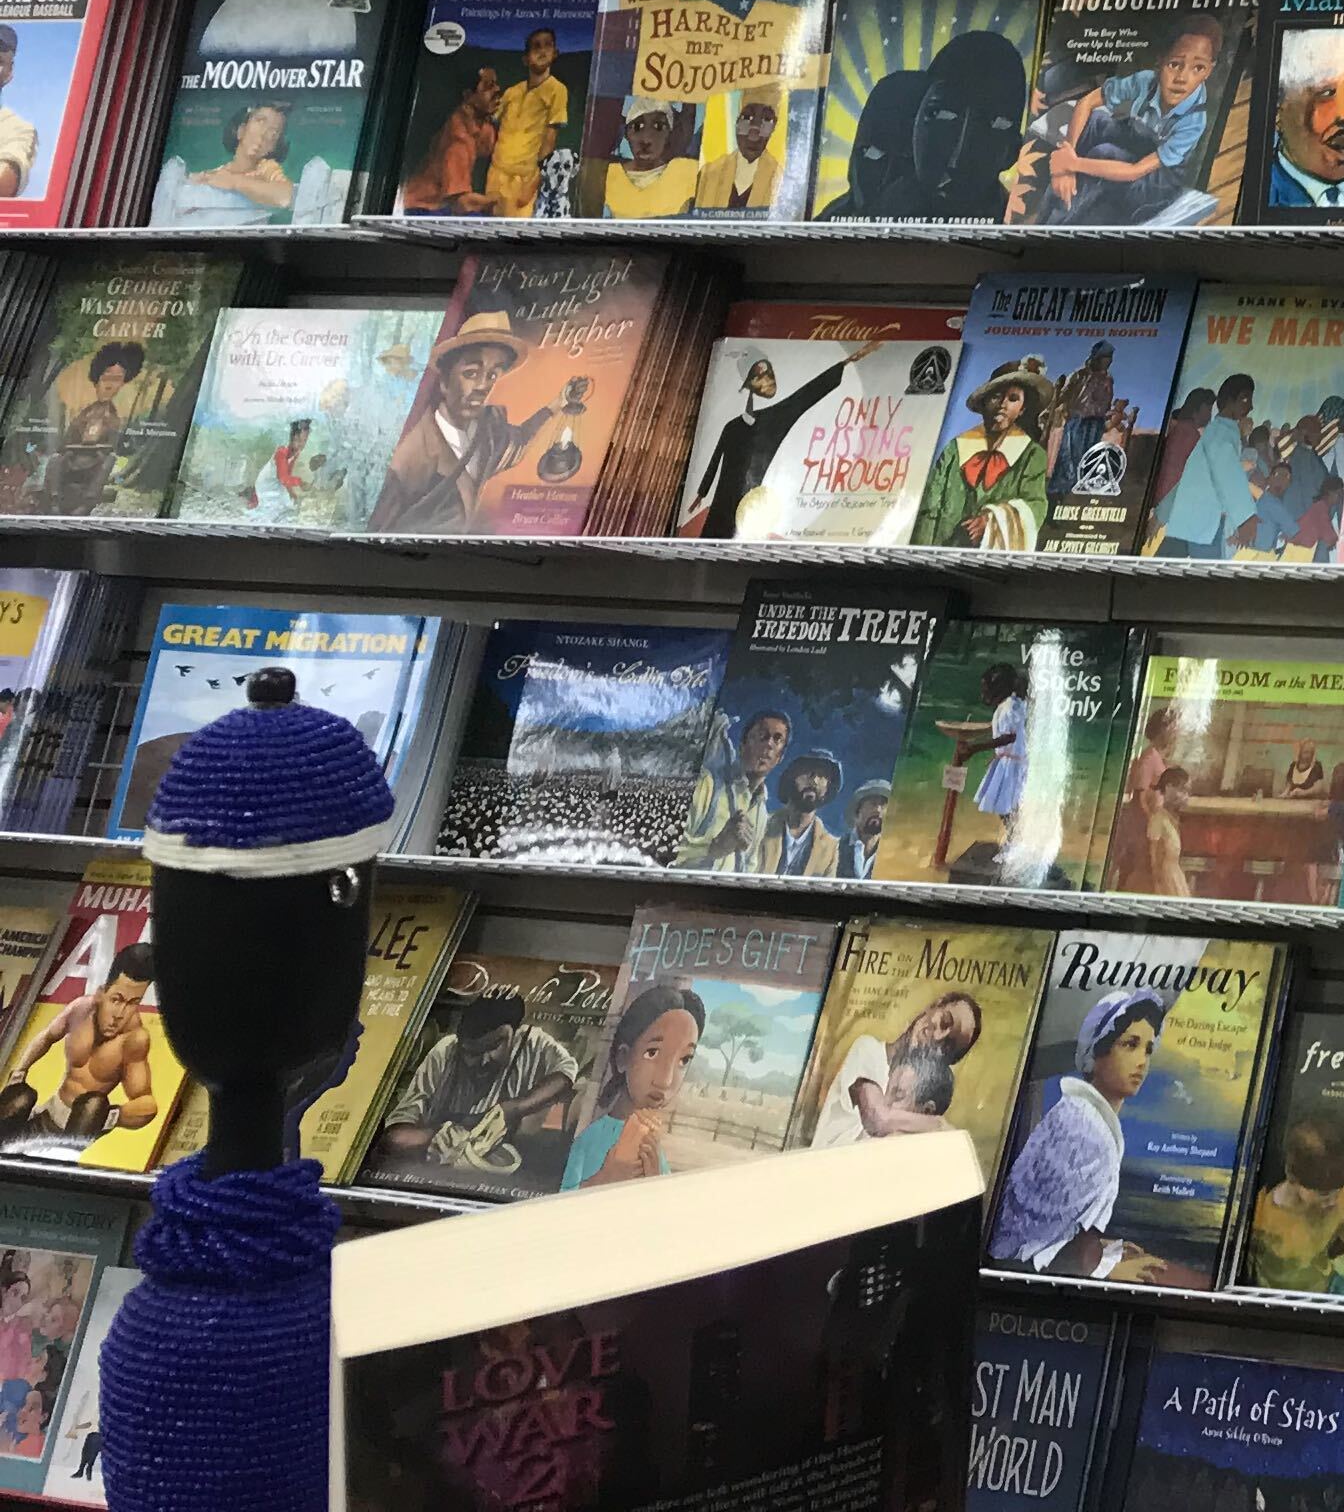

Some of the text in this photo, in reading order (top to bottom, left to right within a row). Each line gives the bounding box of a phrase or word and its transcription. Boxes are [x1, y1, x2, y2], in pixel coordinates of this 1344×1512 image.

[32, 3, 75, 18] BASEBALL
[651, 7, 773, 41] HARRIET
[181, 59, 365, 89] THE MOON OVER STAR
[641, 51, 807, 94] SOJOURNER
[107, 277, 181, 296] GEORGE
[79, 297, 195, 318] WASHINGTON
[92, 319, 167, 339] CARVER
[1058, 943, 1261, 1011] Runaway
[1163, 1377, 1341, 1435] A Path of Stars
[968, 1425, 1063, 1497] WORLD
